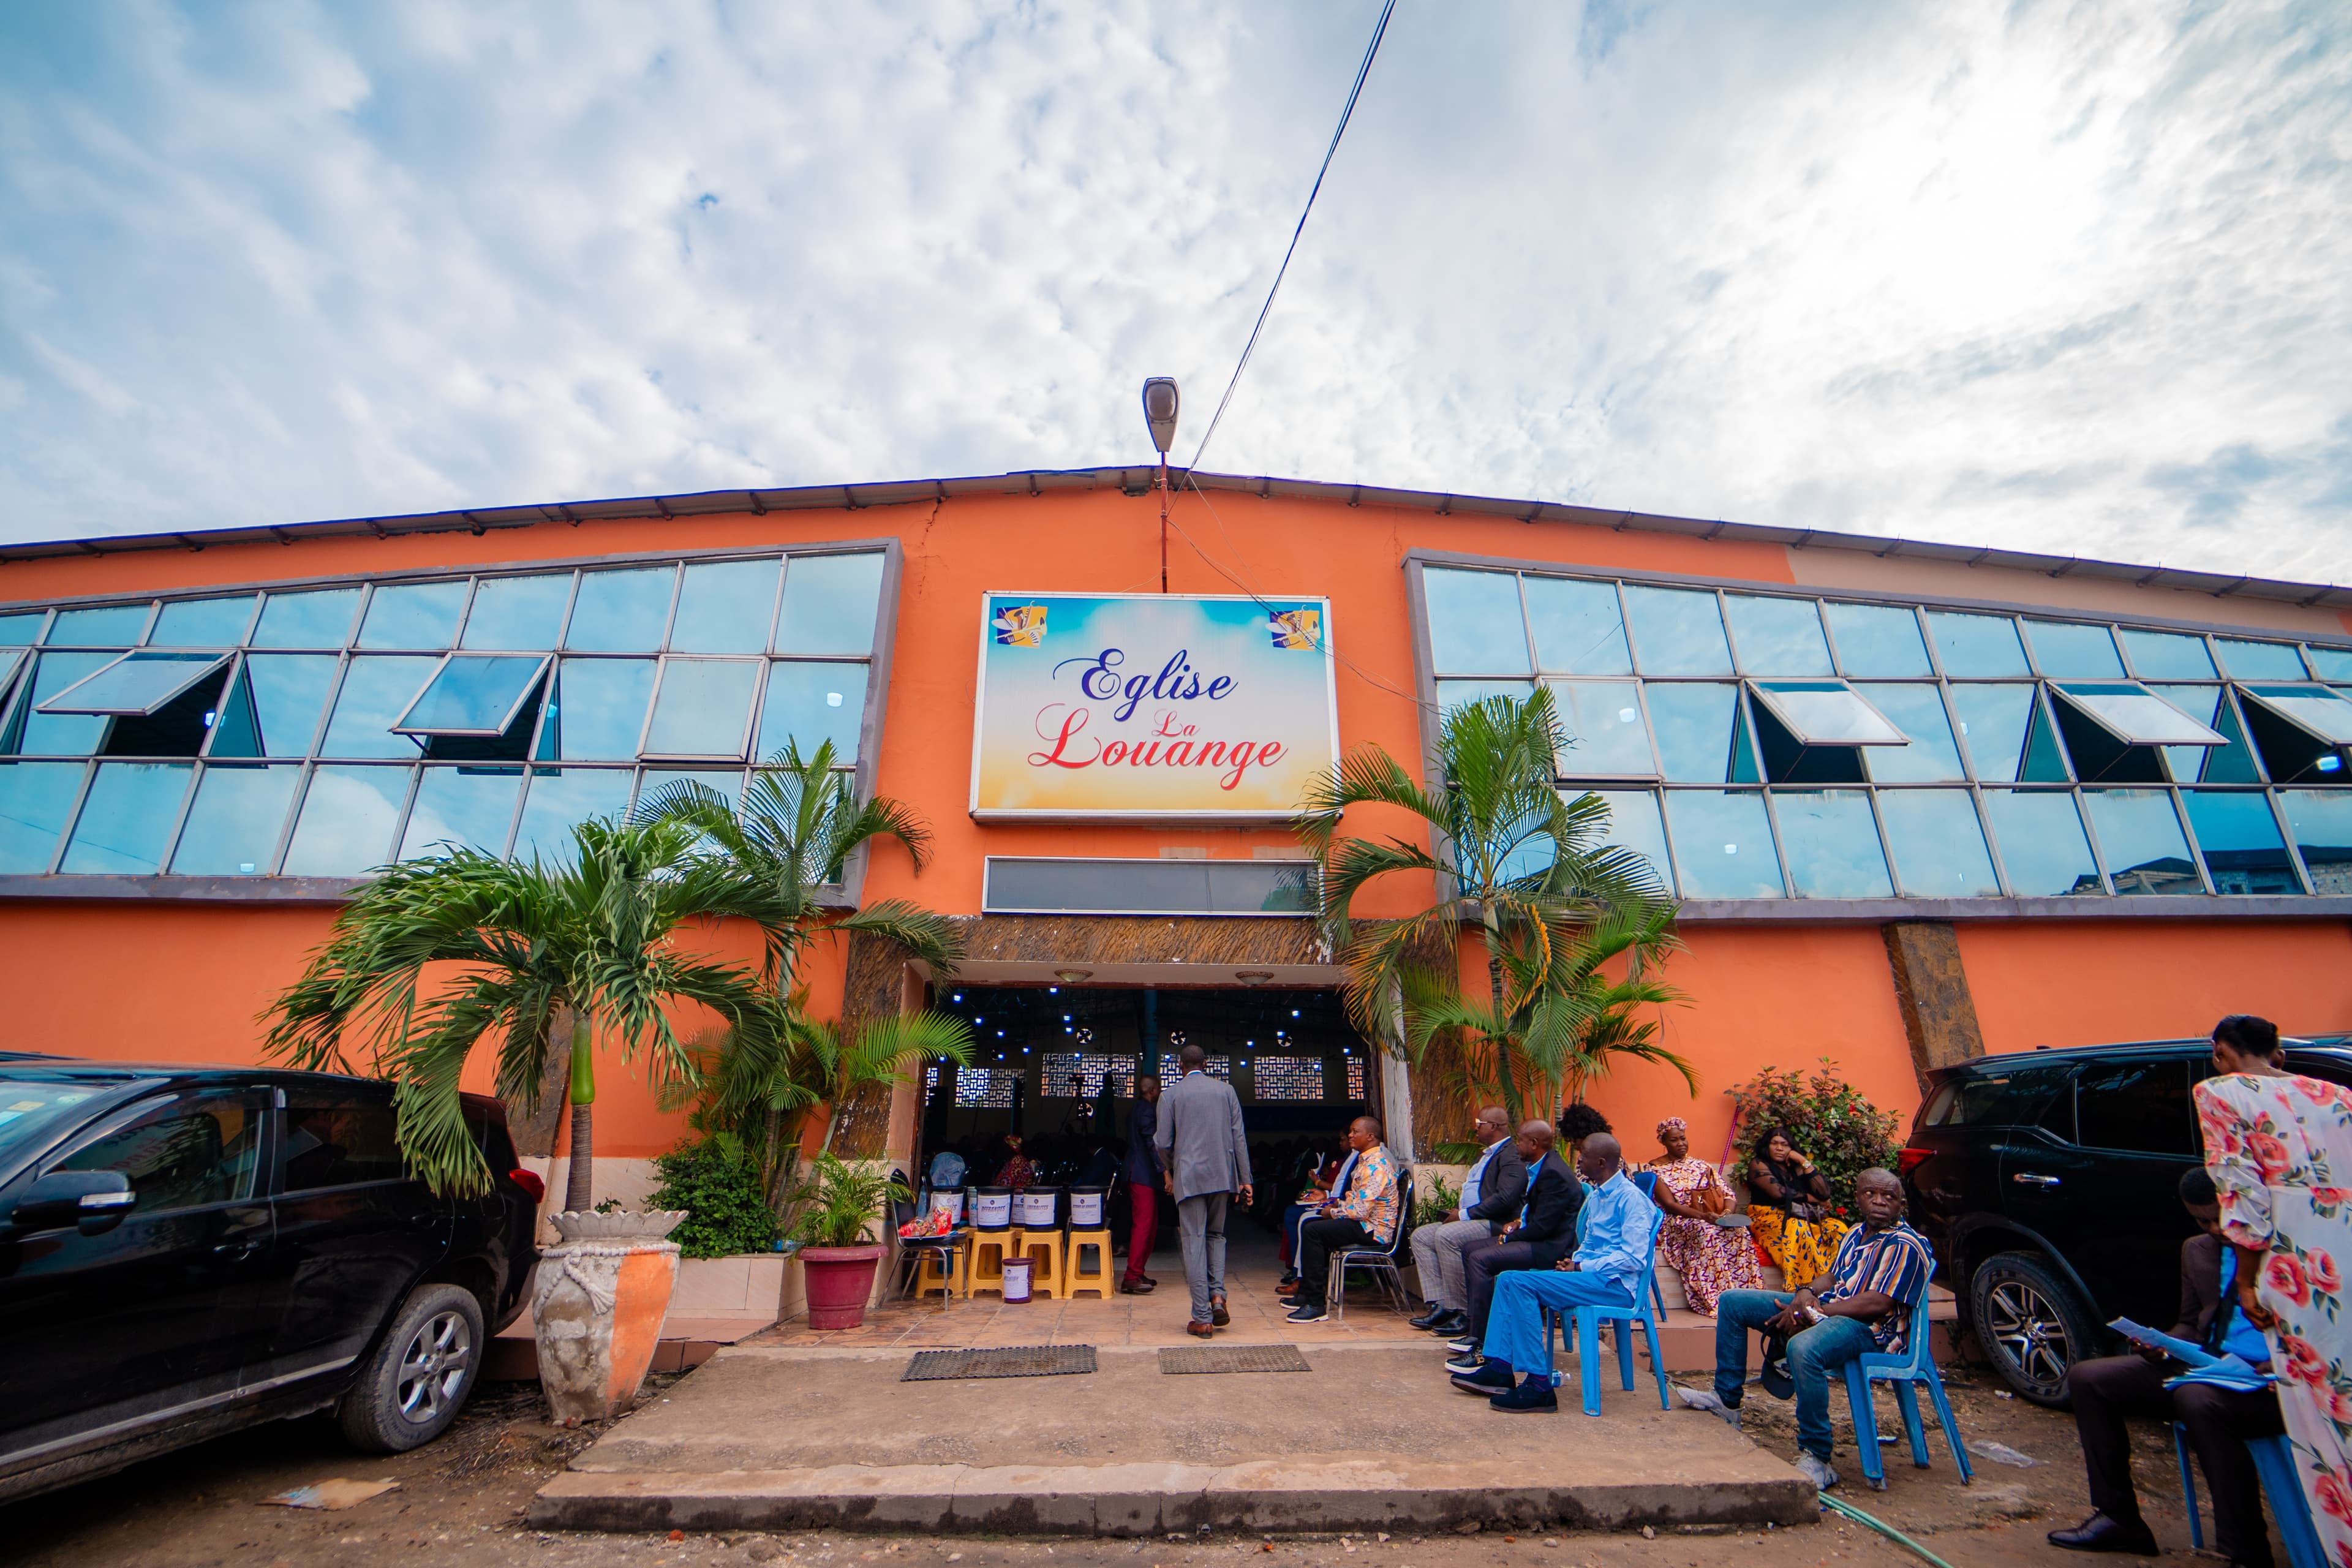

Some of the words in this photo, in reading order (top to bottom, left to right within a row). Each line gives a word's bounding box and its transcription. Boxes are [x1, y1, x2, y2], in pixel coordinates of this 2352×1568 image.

[1053, 648, 1238, 722] Eglise
[1027, 703, 1289, 791] Louange
[1152, 709, 1200, 737] La
